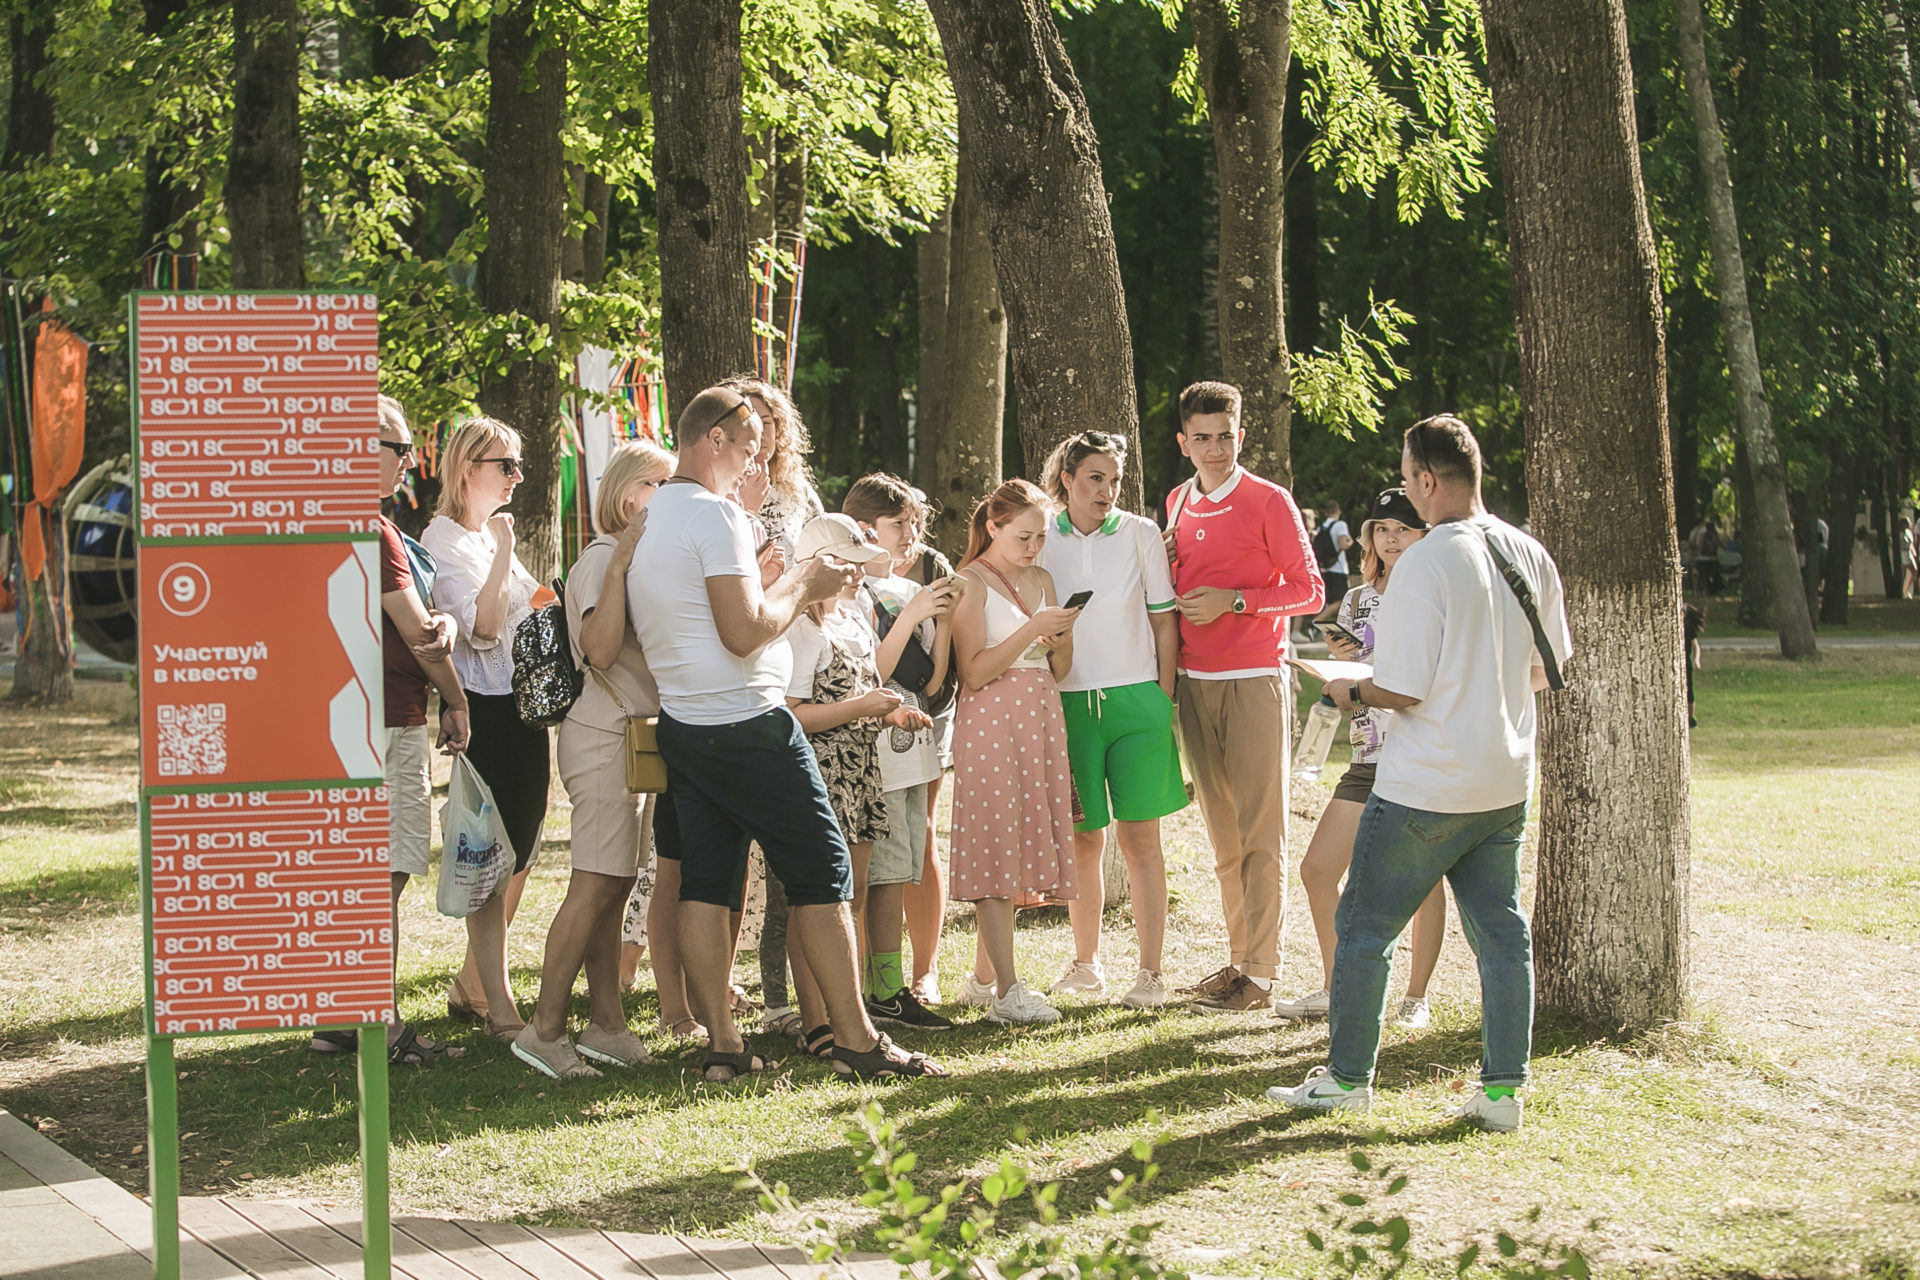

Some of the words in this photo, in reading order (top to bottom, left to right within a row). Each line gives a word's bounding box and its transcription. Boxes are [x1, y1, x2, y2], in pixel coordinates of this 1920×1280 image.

[172, 576, 195, 602] 9
[153, 641, 268, 664] Участвуй
[154, 669, 168, 683] в
[173, 666, 258, 682] квесте
